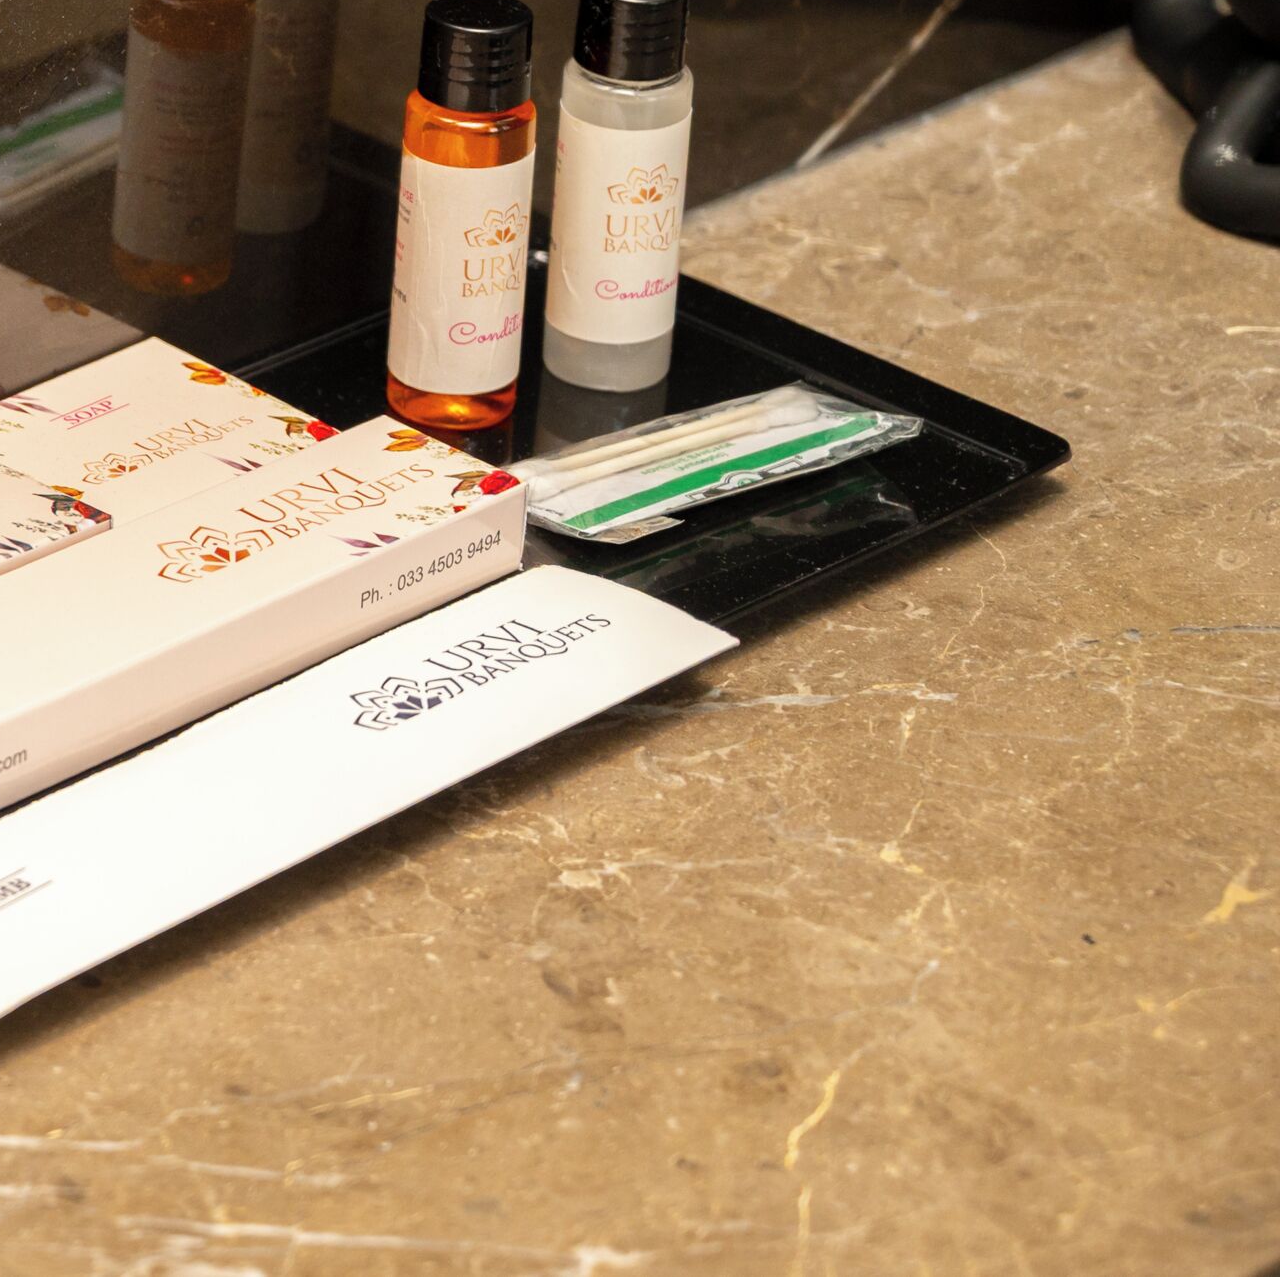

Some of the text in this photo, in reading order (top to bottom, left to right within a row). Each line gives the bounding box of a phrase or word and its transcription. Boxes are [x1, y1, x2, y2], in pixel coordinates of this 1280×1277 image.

[606, 206, 676, 238] URVI
[463, 243, 525, 282] URVI
[63, 399, 113, 425] SOAP
[133, 418, 212, 452] URVI
[153, 415, 254, 459] BANQUETS
[236, 466, 367, 524] URVI
[272, 463, 435, 539] BANQUETS
[360, 589, 383, 609] Ph.
[397, 566, 424, 591] 033
[428, 548, 463, 575] 4503
[467, 530, 501, 559] 9494
[423, 619, 546, 671] URVI
[459, 613, 611, 686] BANQUETS
